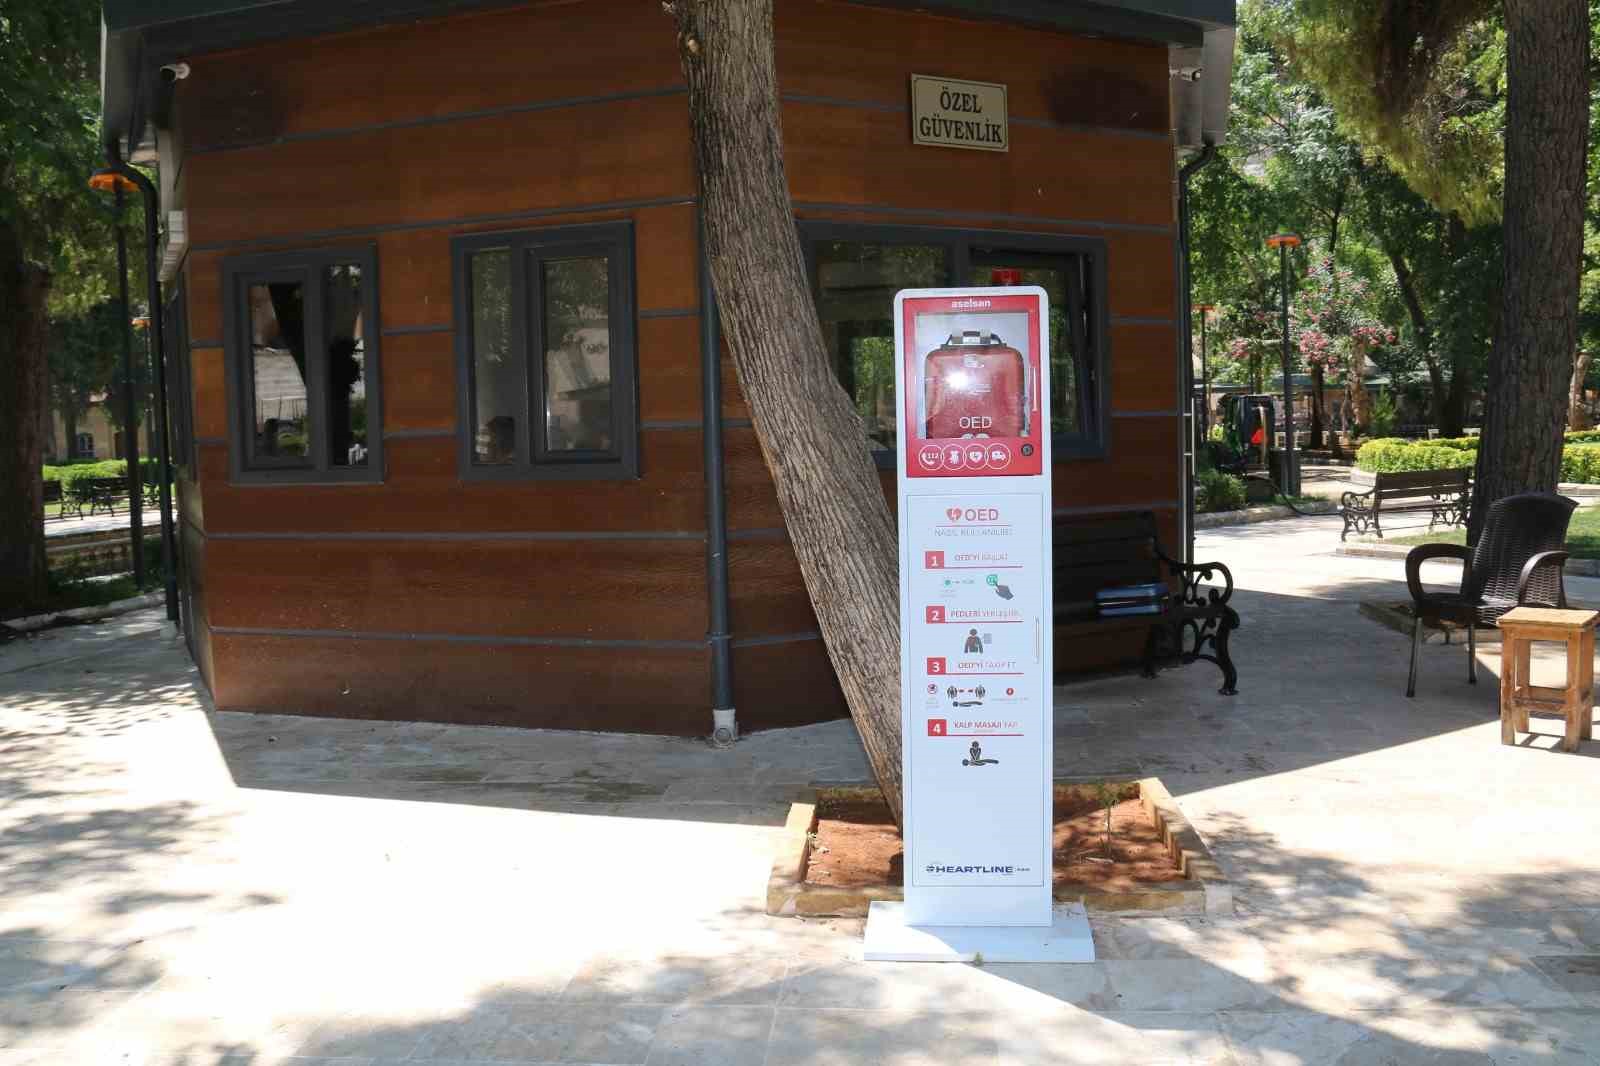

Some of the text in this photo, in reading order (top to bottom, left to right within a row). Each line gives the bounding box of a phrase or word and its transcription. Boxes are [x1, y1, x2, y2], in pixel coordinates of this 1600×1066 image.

[940, 86, 982, 113] ÖZEL
[920, 112, 1002, 143] GÜVENLİK
[951, 299, 991, 308] aselsan
[959, 416, 992, 429] OED
[965, 508, 999, 521] OED
